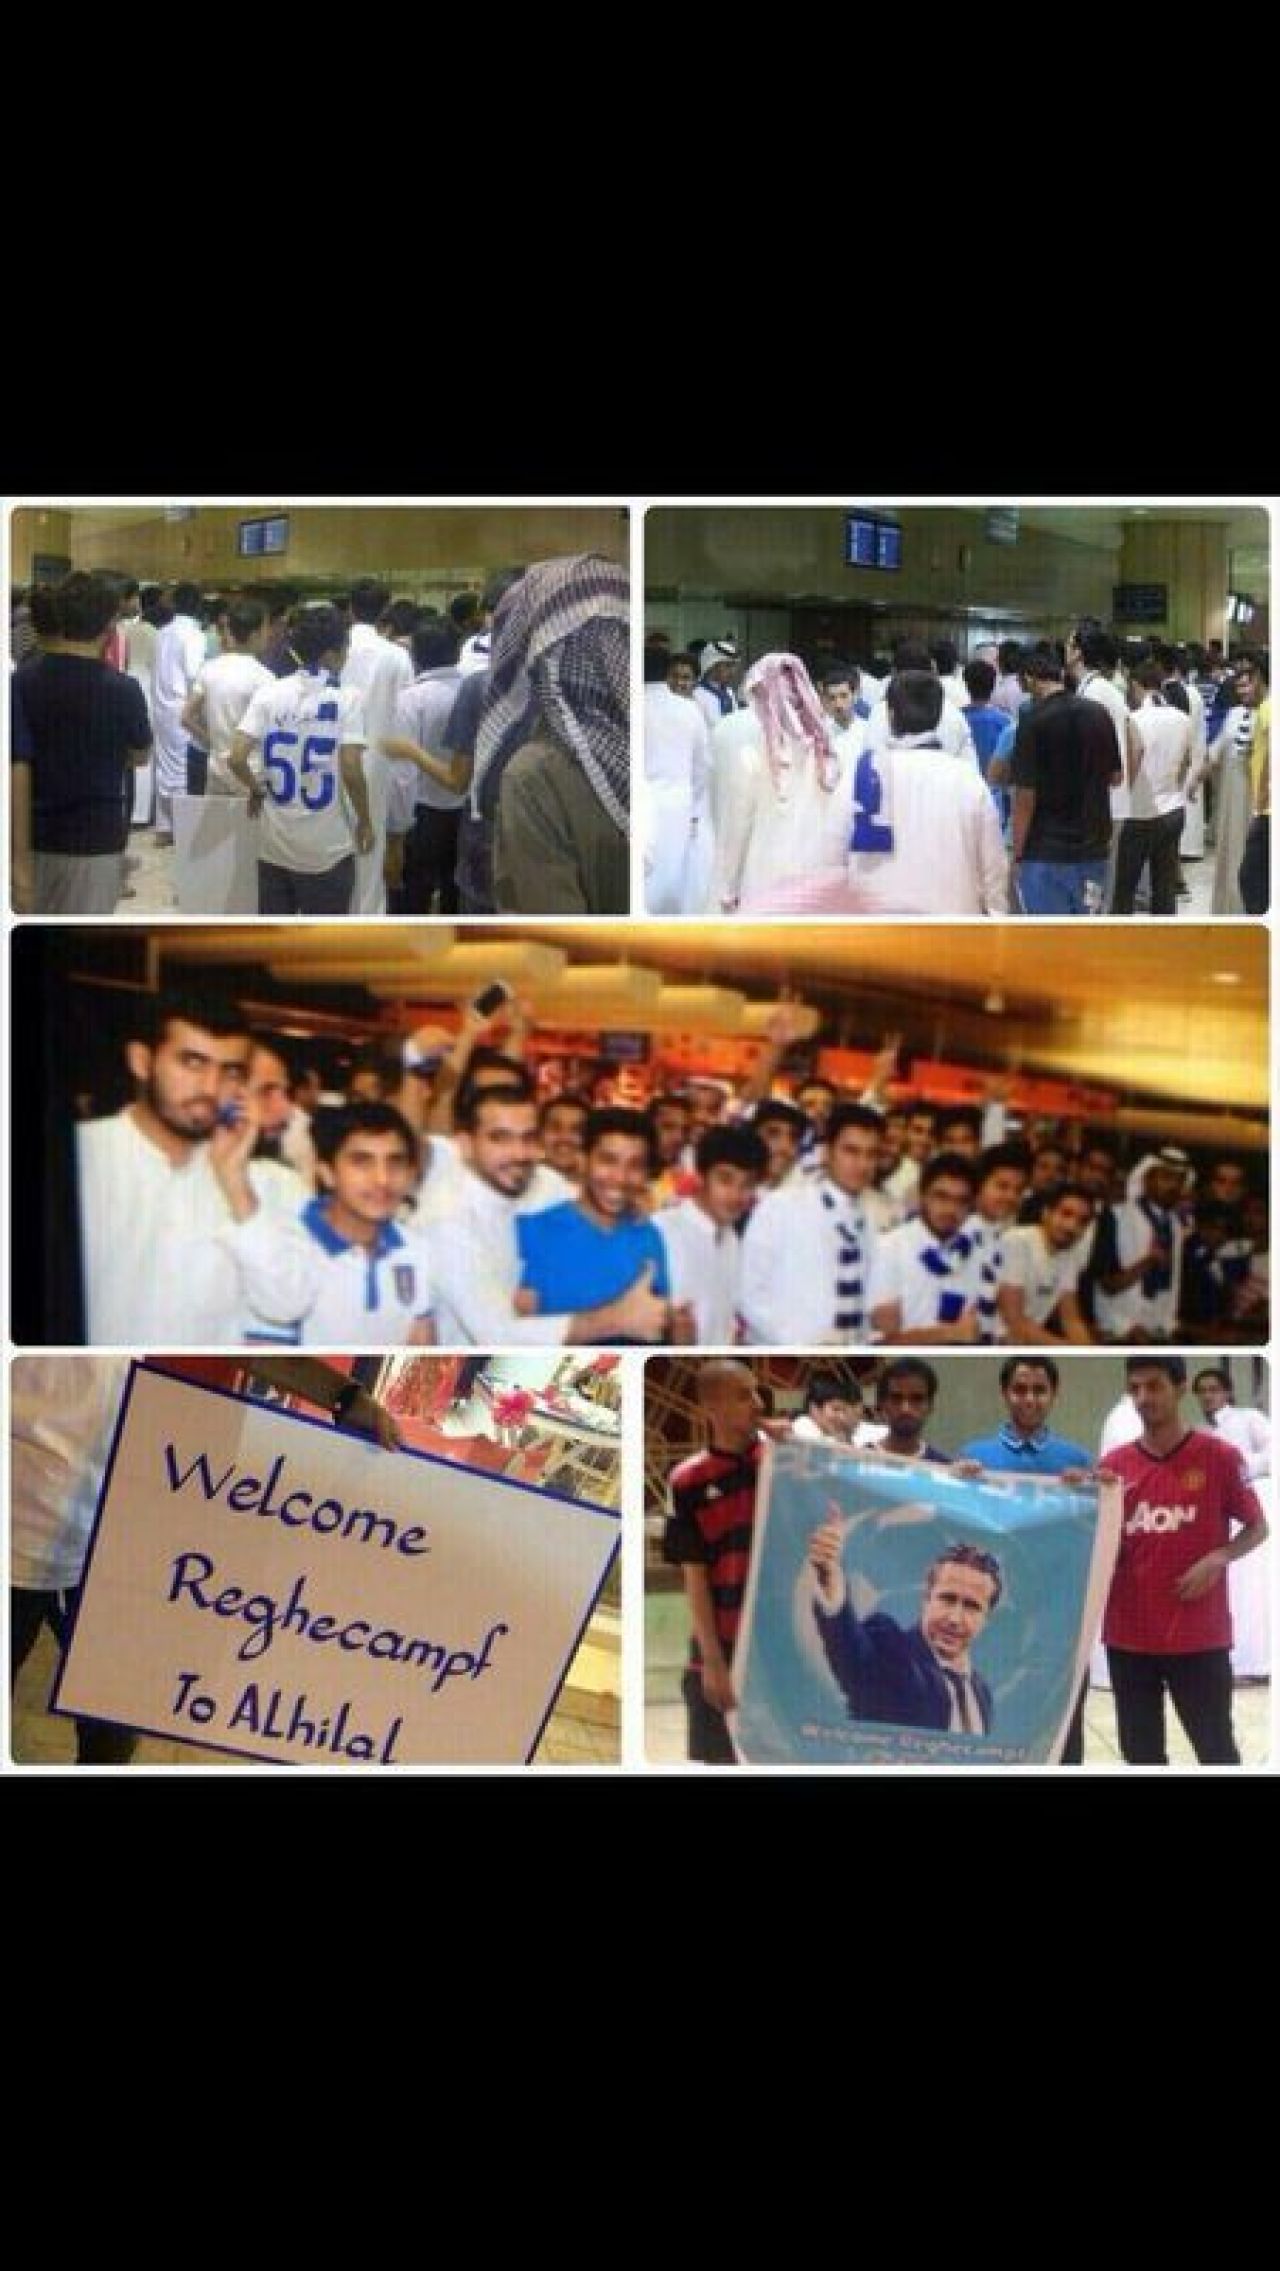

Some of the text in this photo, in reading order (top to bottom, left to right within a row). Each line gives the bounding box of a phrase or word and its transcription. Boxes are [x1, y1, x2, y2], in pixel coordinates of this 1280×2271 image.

[263, 731, 337, 811] 55
[165, 1444, 431, 1554] Welcome
[168, 1552, 509, 1692] Reghecampf
[173, 1673, 216, 1724] To
